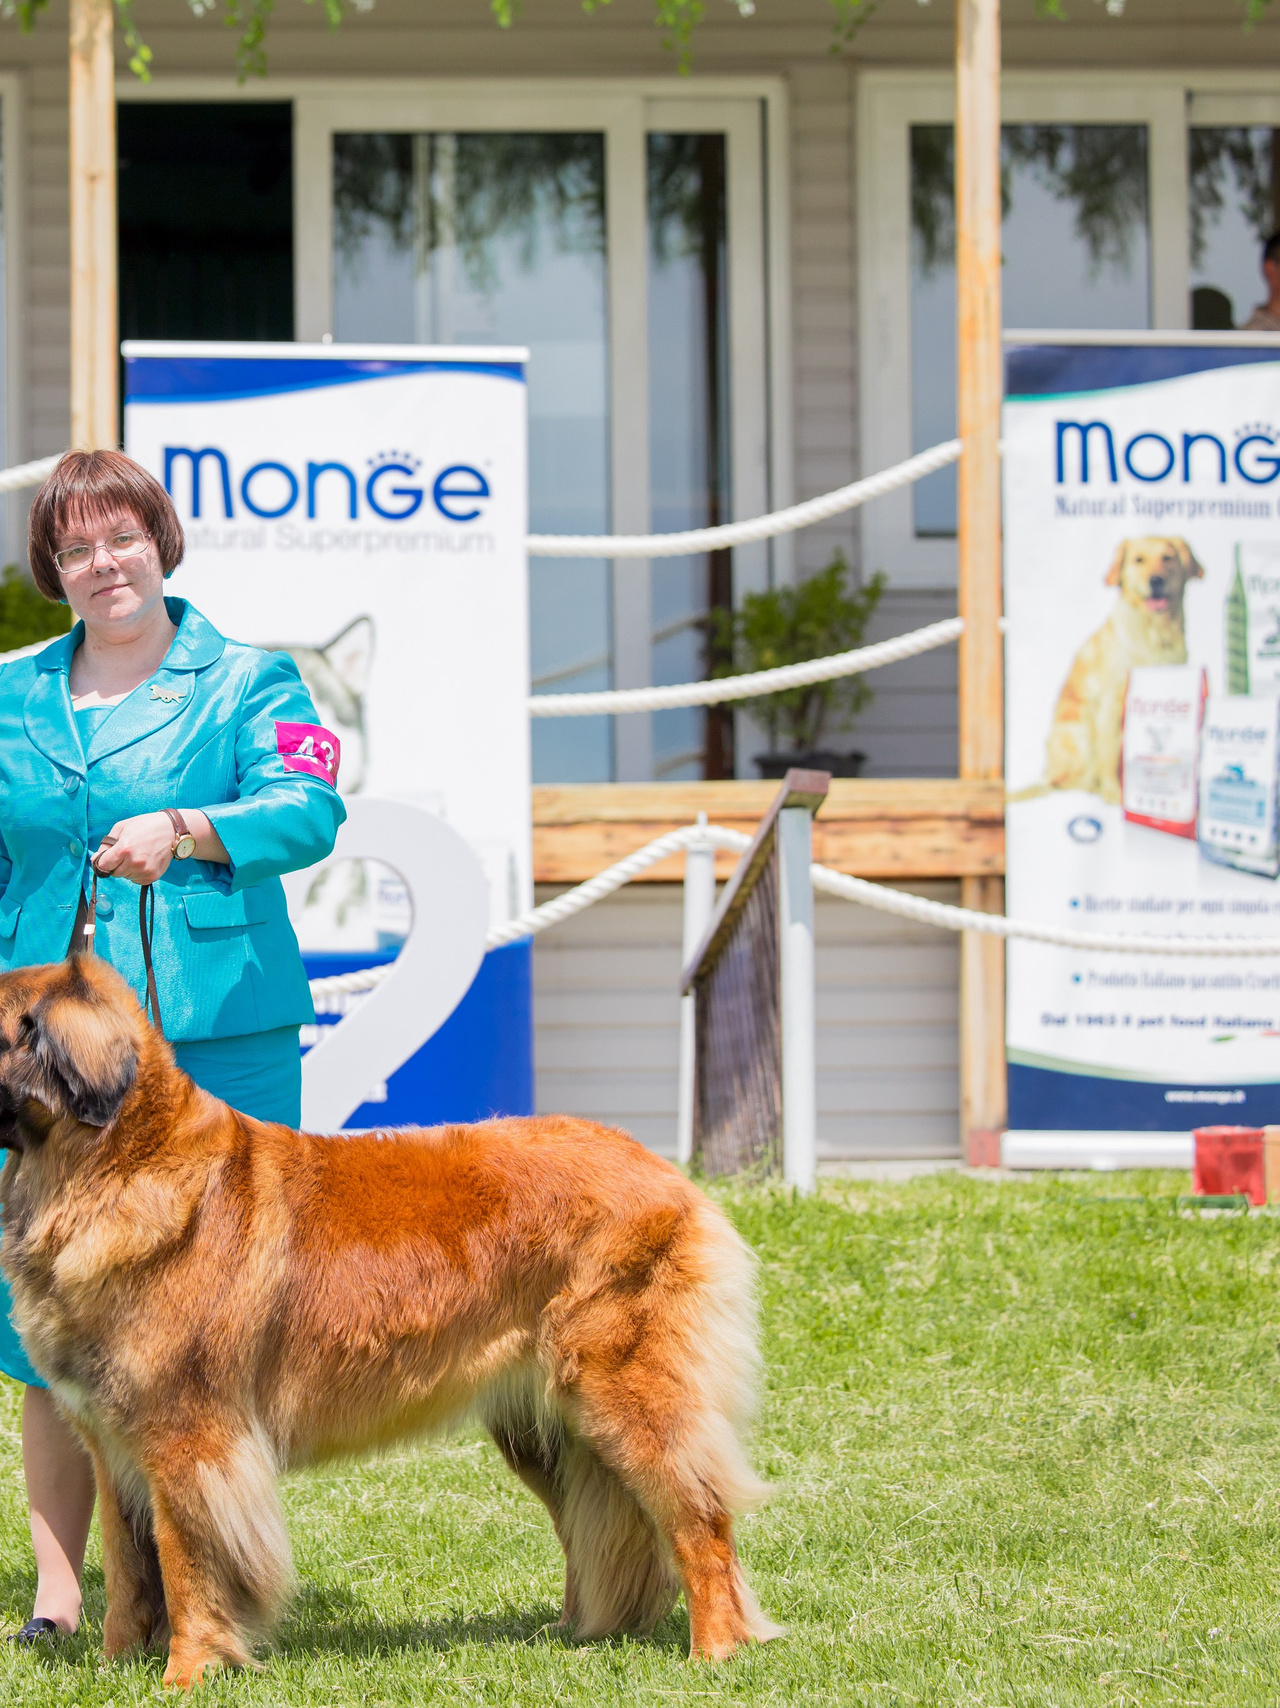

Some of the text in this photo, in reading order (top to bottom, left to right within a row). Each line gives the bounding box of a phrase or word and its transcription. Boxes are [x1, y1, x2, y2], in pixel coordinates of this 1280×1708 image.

[1055, 494, 1127, 517] Natural
[1131, 493, 1270, 520] Superpremium
[186, 523, 497, 555] atural Superpremium
[280, 795, 488, 1130] 2
